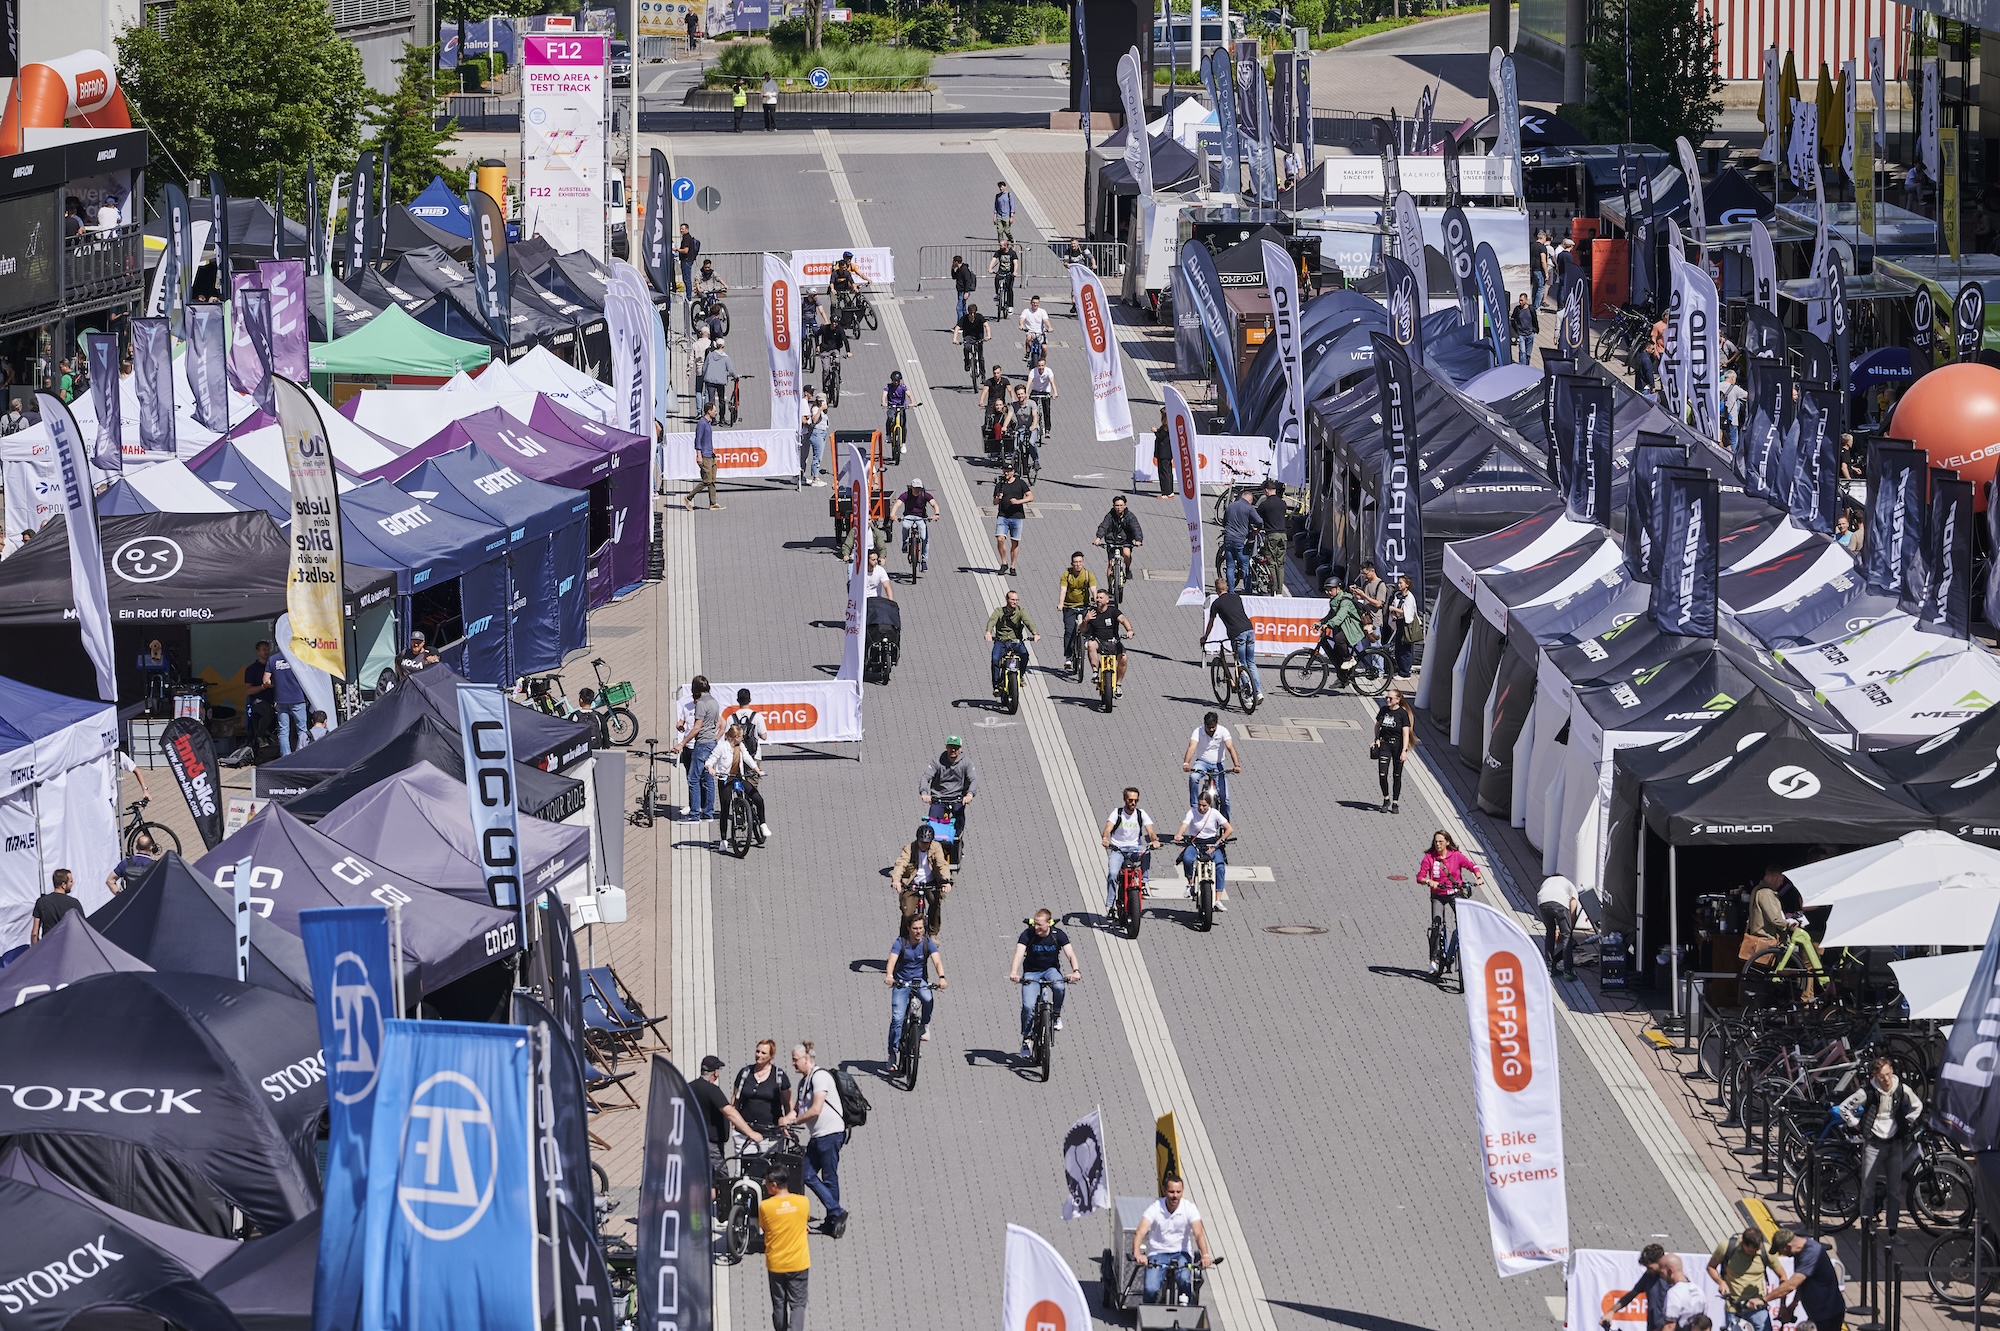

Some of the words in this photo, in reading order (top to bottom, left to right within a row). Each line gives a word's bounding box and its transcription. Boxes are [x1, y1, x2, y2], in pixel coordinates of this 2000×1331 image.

[546, 42, 582, 60] F12
[79, 77, 105, 100] BAFANG
[530, 84, 554, 92] TEST
[558, 84, 591, 92] TRACK
[530, 187, 551, 197] F12
[354, 172, 366, 268] HARO
[775, 288, 787, 344] BAFANG
[1084, 292, 1103, 345] BAFANG
[585, 322, 603, 336] HARO
[553, 333, 573, 345] HARO
[510, 345, 528, 358] HARO
[1094, 385, 1122, 400] Systems
[122, 446, 146, 455] MAHA
[497, 429, 547, 458] Liv
[1221, 448, 1248, 456] E-Bike
[716, 452, 759, 463] AFANG
[1177, 424, 1192, 490] BAFANG
[1936, 449, 1985, 469] VELO
[473, 467, 523, 495] GIANT
[1465, 485, 1542, 493] STROMER
[377, 505, 432, 536] GIANT
[414, 568, 432, 585] GIANT
[119, 609, 134, 618] Ein
[137, 609, 158, 618] Rad
[161, 608, 176, 618] für
[179, 608, 214, 619] alle(s).
[467, 615, 494, 640] GIANT
[761, 710, 807, 724] FANG
[10, 765, 35, 787] MAHLE
[165, 742, 201, 818] www.inno-bike.com
[547, 797, 565, 822] YOUR
[567, 785, 585, 818] RIDE
[1706, 824, 1772, 834] SIMPLON
[5, 832, 35, 853] MAHLE
[1602, 955, 1624, 963] BINDING
[1494, 967, 1522, 1077] BAFANG
[1485, 1130, 1537, 1148] E-Bike
[1487, 1149, 1532, 1167] Drive
[1490, 1167, 1558, 1188] Systems
[1500, 1245, 1568, 1261] bafang-e.com
[0, 1235, 124, 1315] STORCK
